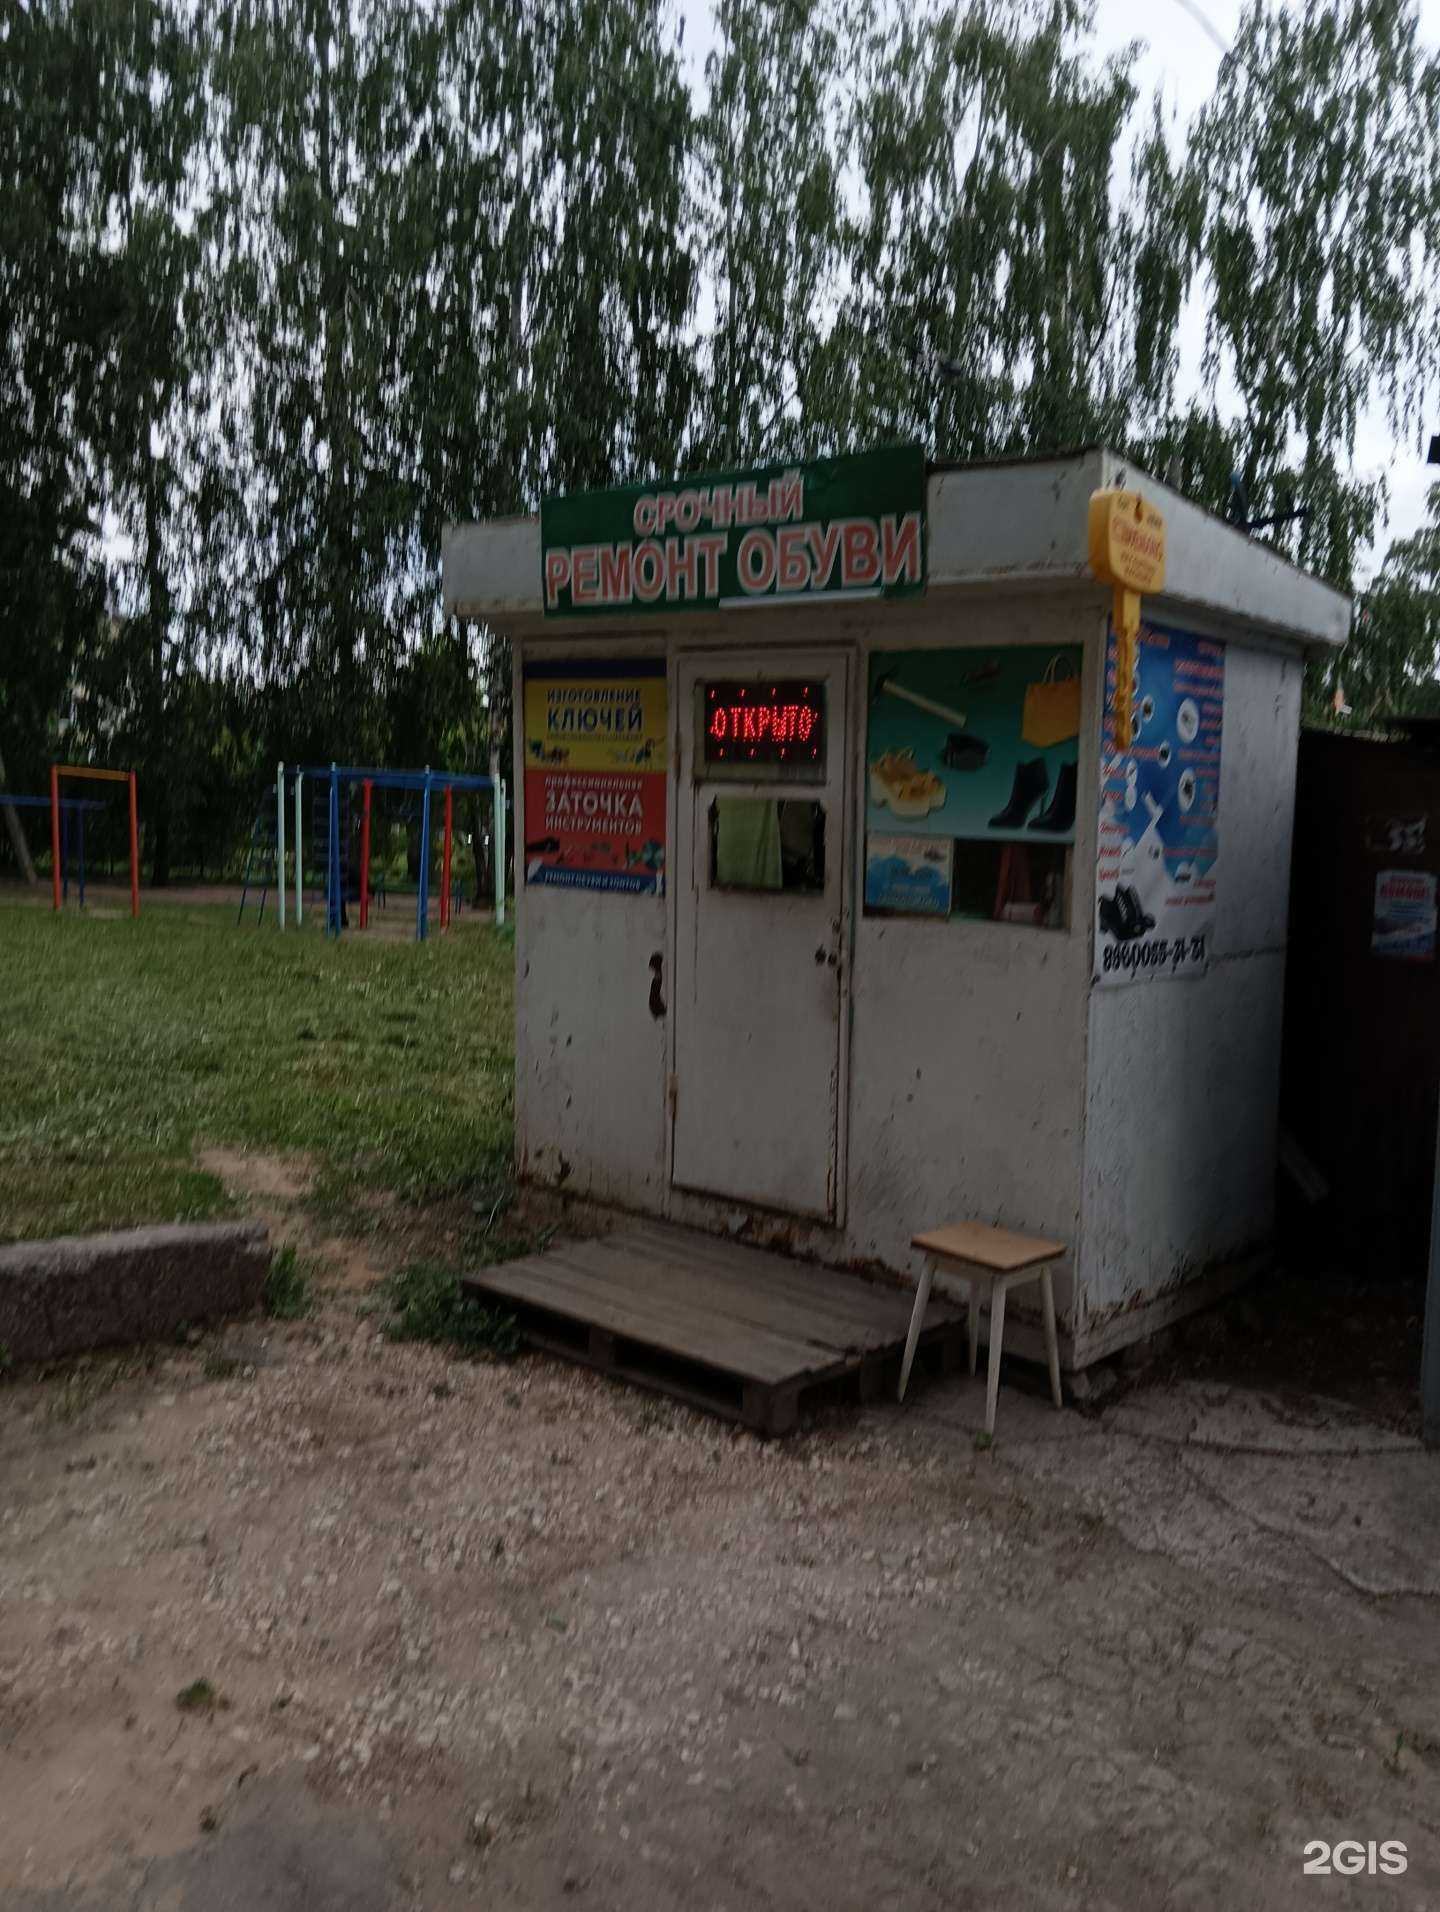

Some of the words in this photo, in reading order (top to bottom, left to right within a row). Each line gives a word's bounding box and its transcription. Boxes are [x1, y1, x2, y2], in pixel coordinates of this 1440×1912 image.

[633, 469, 805, 538] СРОЧНЫЙ
[544, 530, 728, 610] РЕМОНТ
[736, 510, 924, 595] ОБУВИ
[546, 703, 643, 733] КЛЮЧЕЙ
[710, 704, 813, 742] ОТКРЫТО
[545, 788, 644, 818] ЗАТОЧКА
